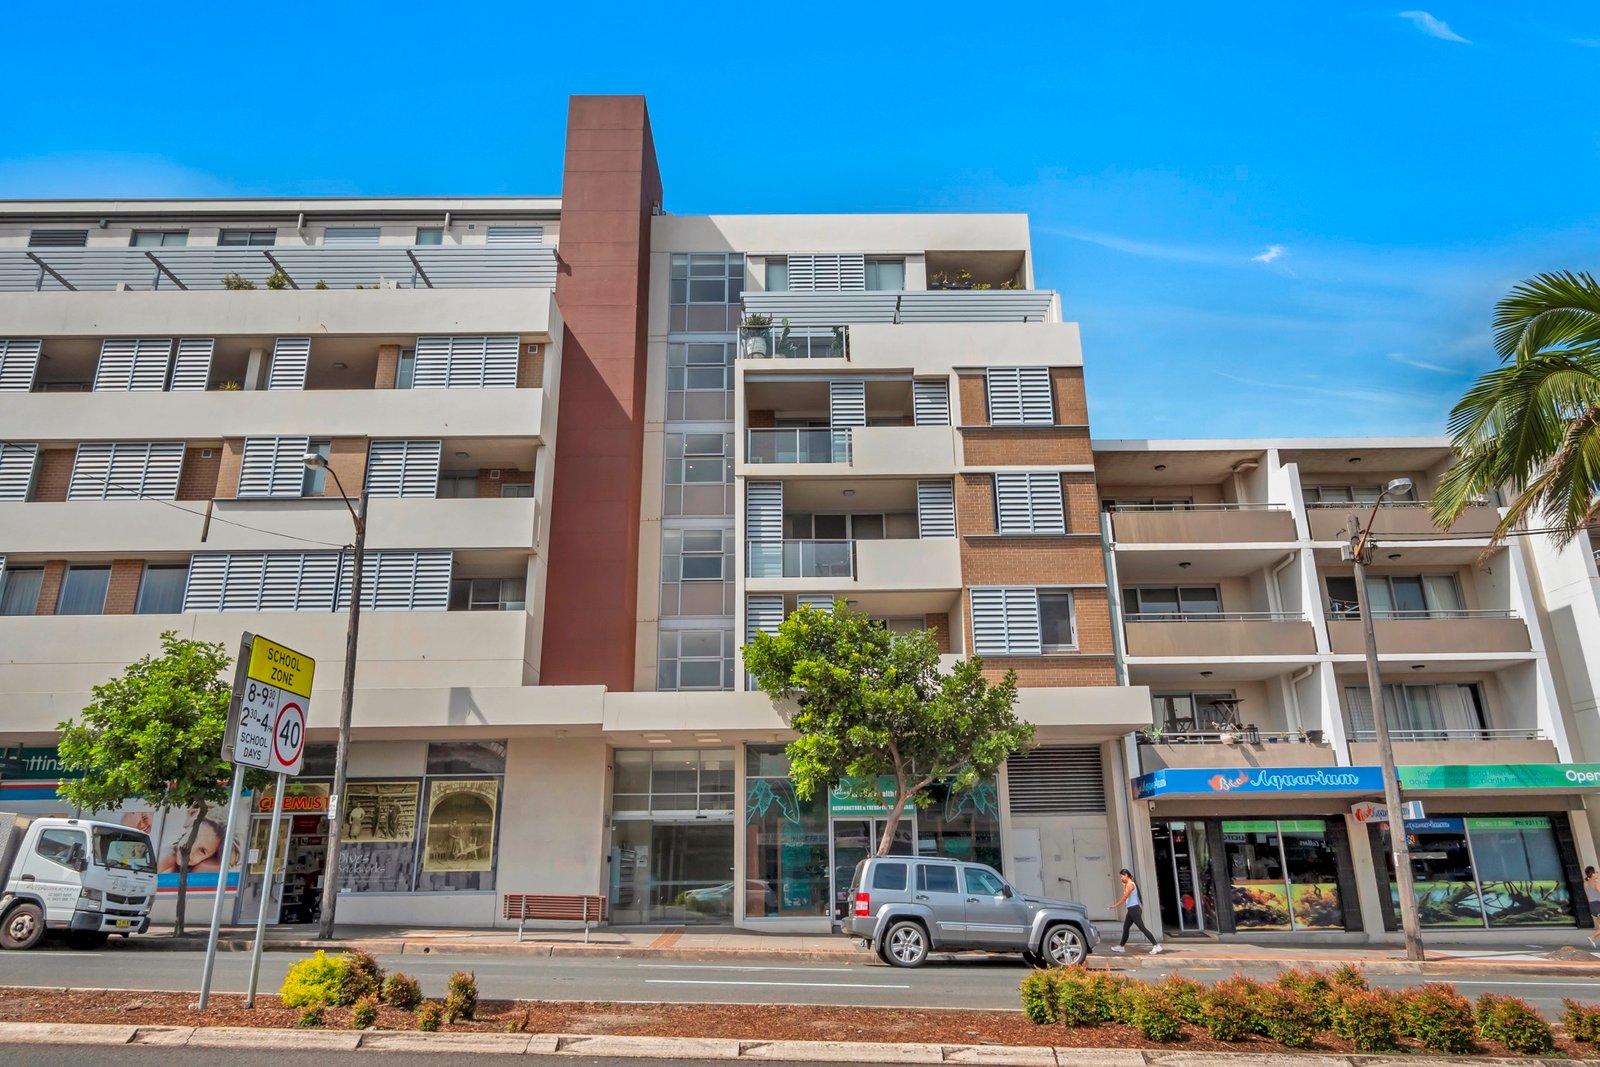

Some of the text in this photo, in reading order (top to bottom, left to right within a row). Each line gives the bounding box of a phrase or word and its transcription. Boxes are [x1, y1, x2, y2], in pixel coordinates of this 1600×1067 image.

[267, 647, 301, 672] SCHOOL
[270, 667, 294, 686] ZONE
[240, 732, 268, 748] SCHOOL
[280, 719, 300, 748] 40
[243, 747, 262, 761] DAYS
[1250, 769, 1359, 790] Aquarium
